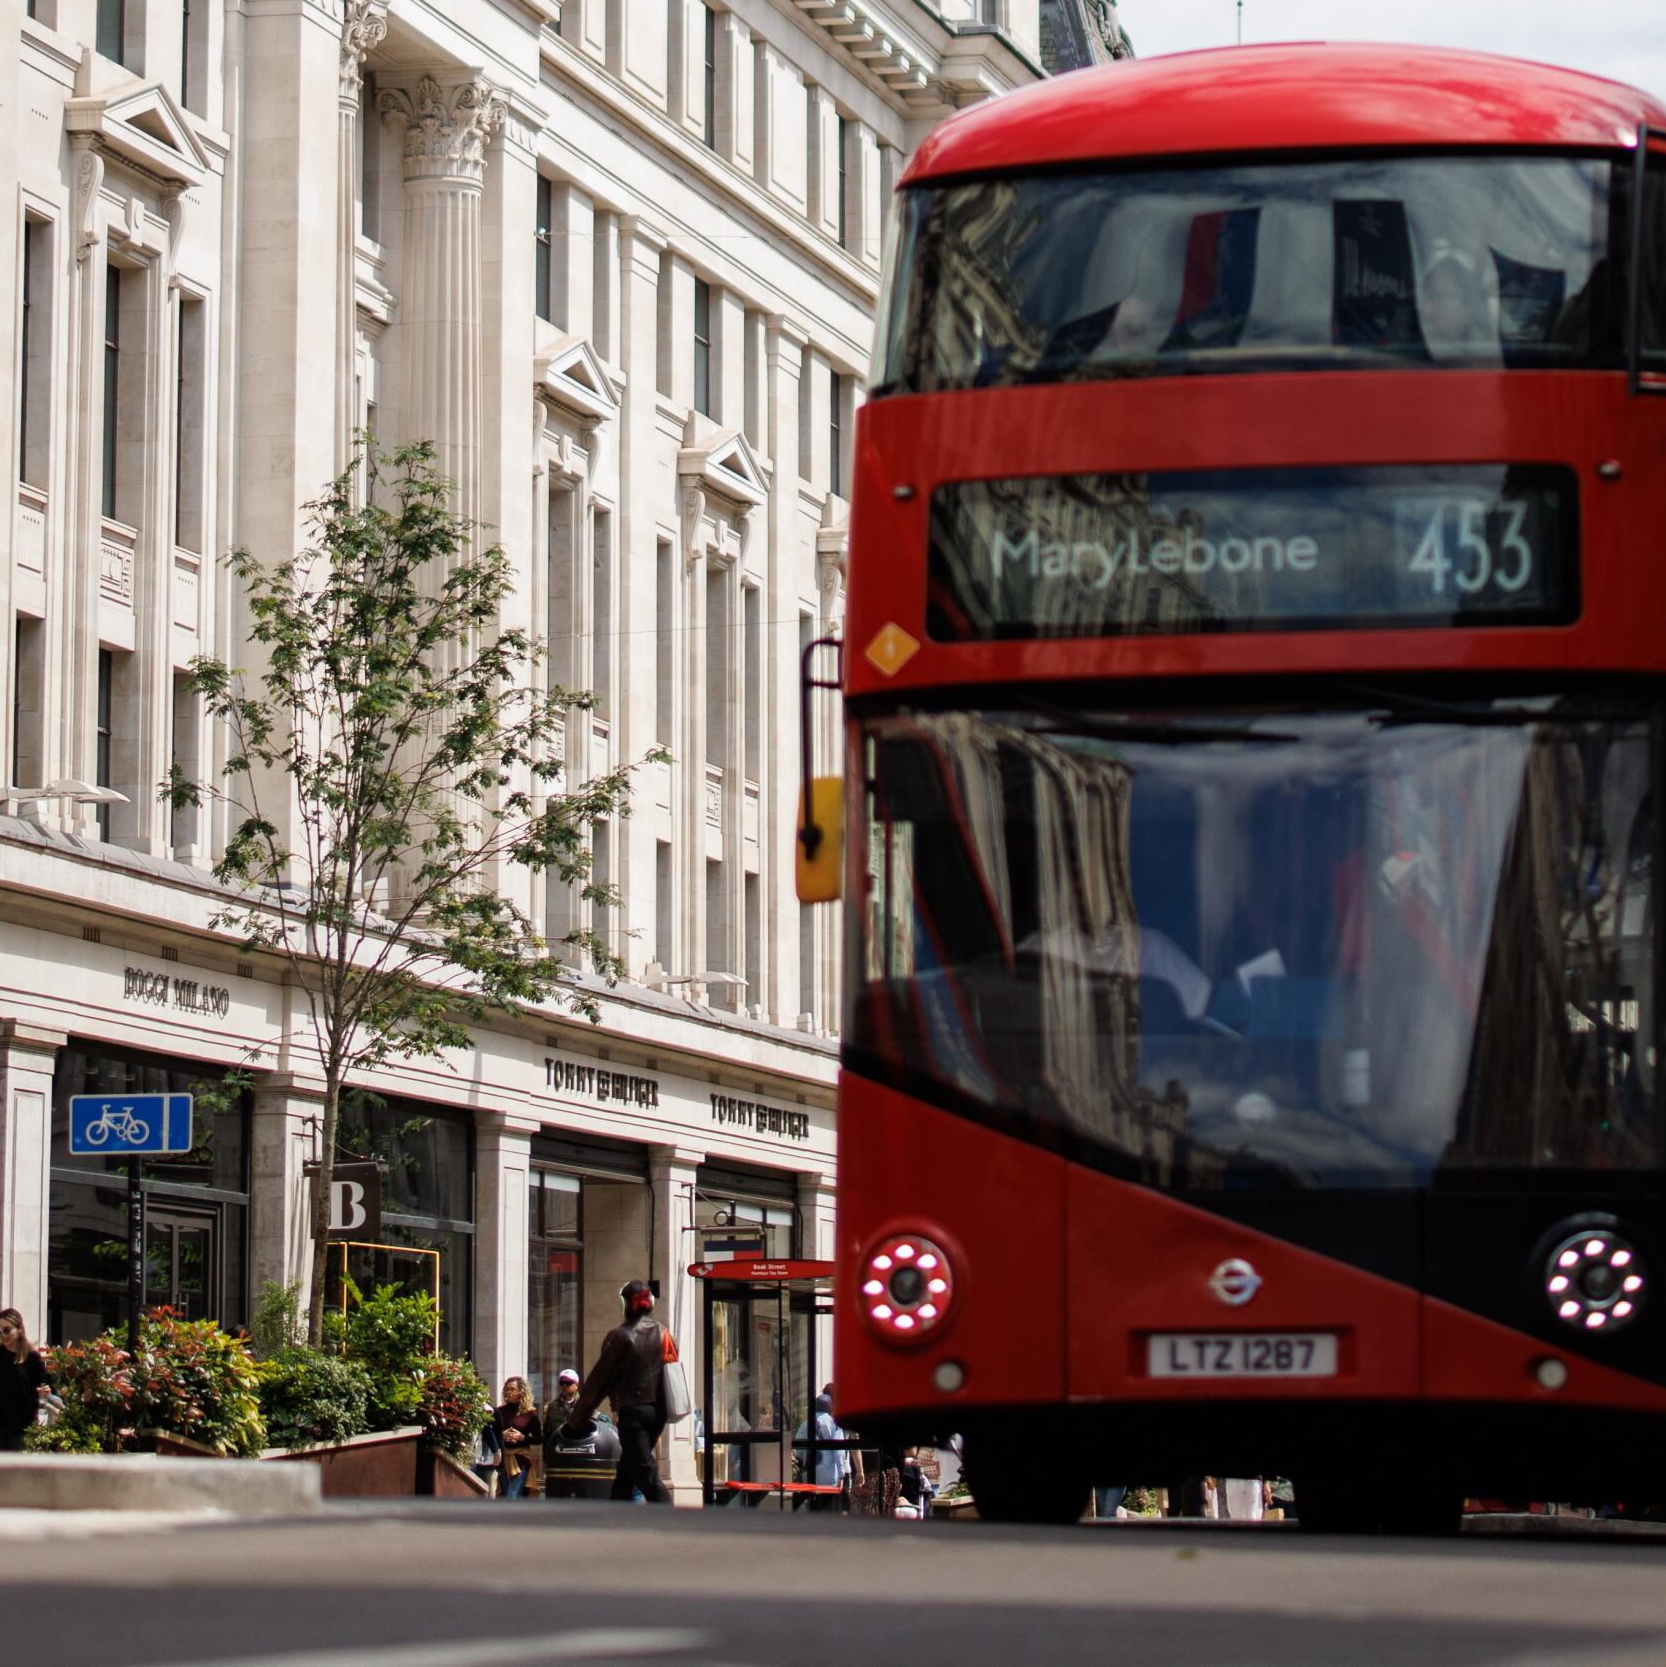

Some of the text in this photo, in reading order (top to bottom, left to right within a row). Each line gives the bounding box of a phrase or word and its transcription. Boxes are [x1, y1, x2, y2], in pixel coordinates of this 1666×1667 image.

[991, 500, 1533, 594] Marylebone 453
[123, 967, 230, 1020] BOGGI MILANO
[545, 1058, 659, 1108] TOMMY HILFIGER
[710, 1093, 810, 1140] TOMMY HILFIGER
[327, 1181, 367, 1229] B
[1170, 1339, 1315, 1371] LTZ 1287
